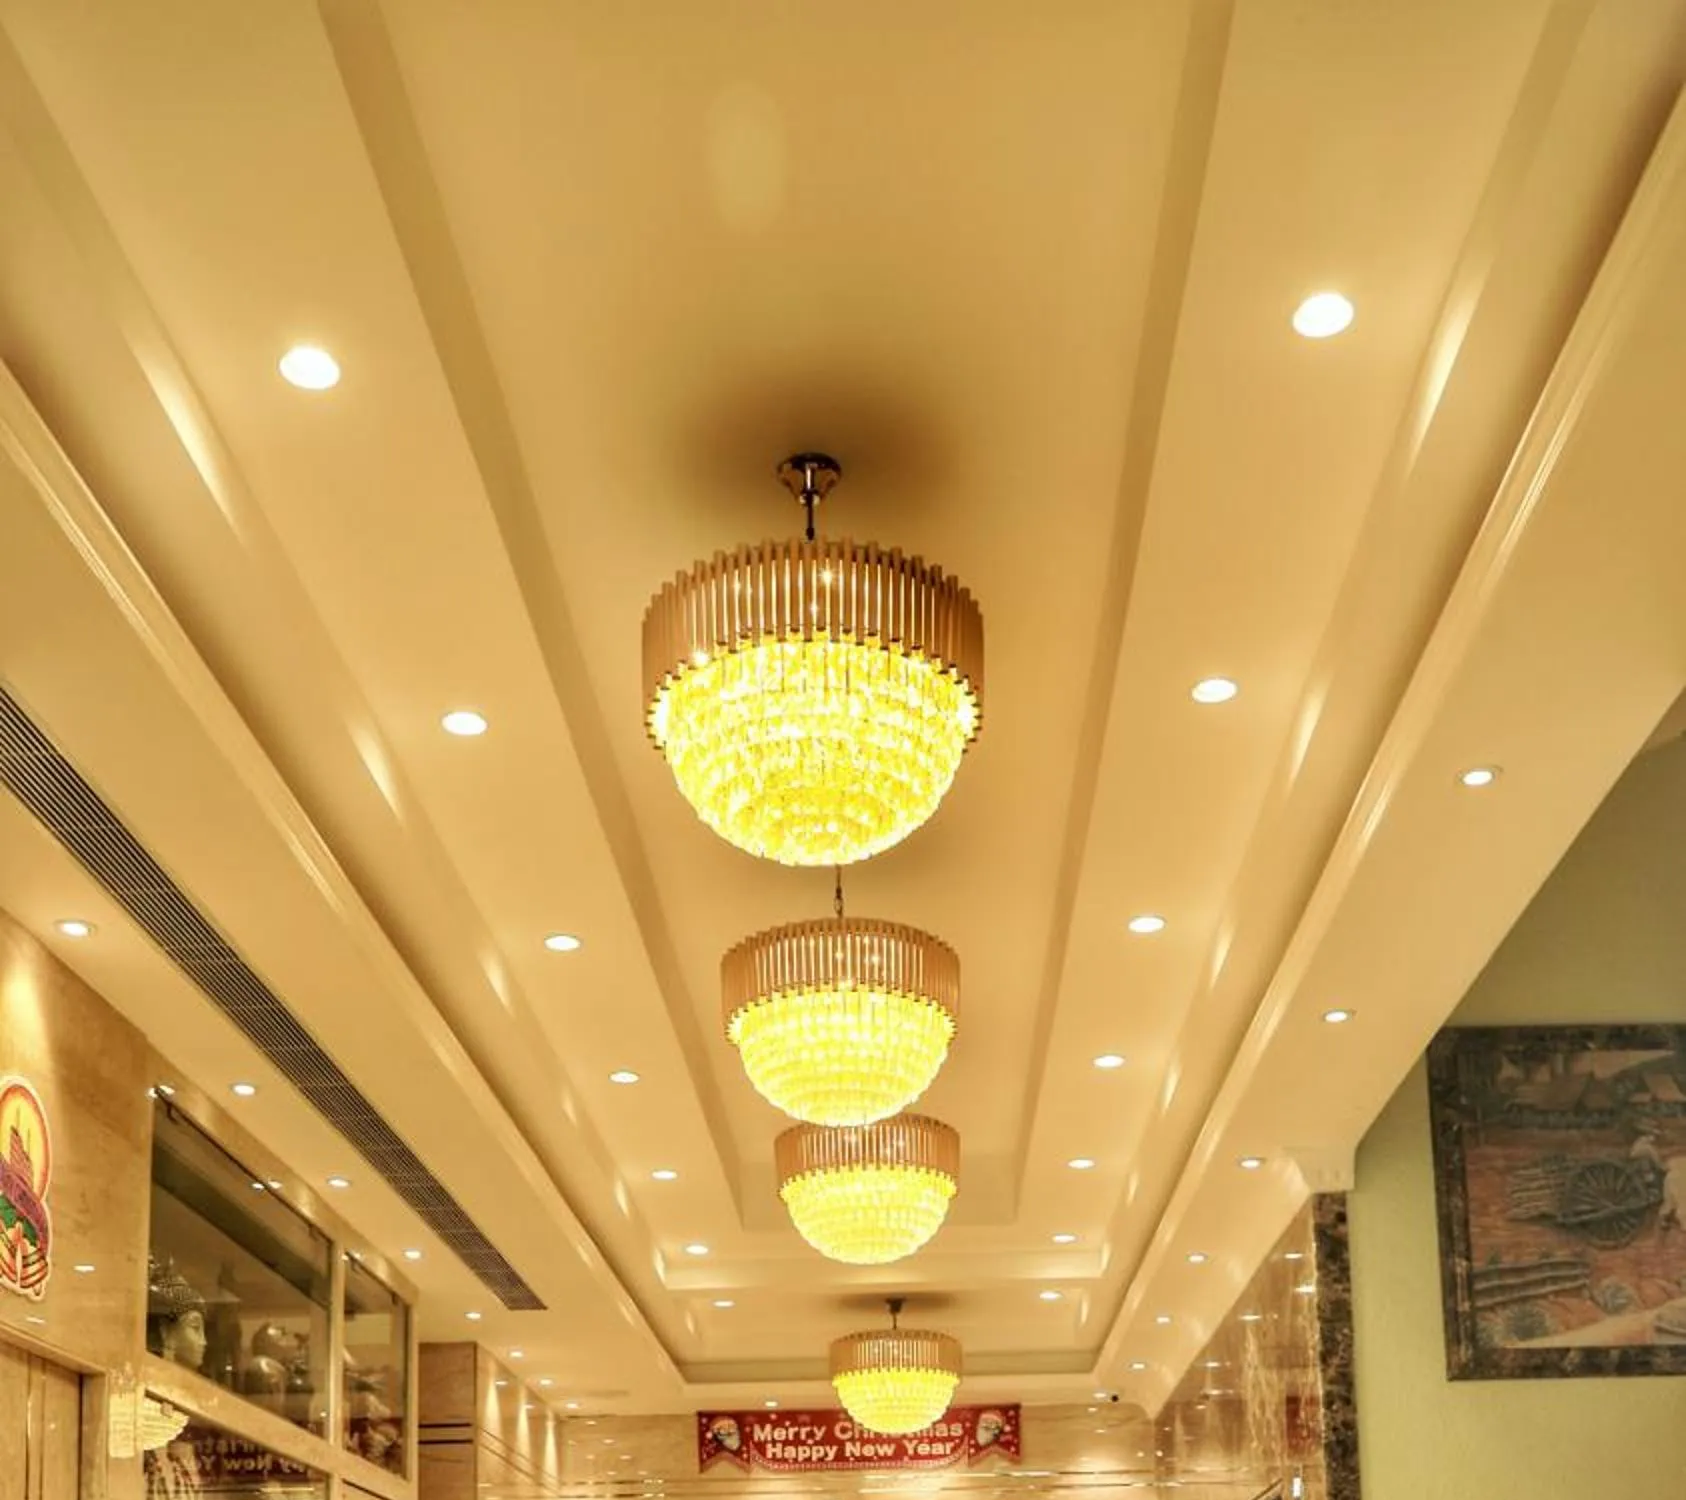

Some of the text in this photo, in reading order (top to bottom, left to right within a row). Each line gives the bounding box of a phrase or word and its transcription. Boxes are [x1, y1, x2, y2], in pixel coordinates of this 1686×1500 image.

[753, 1421, 963, 1442] Merry Chmas
[766, 1439, 956, 1461] Happy New Year
